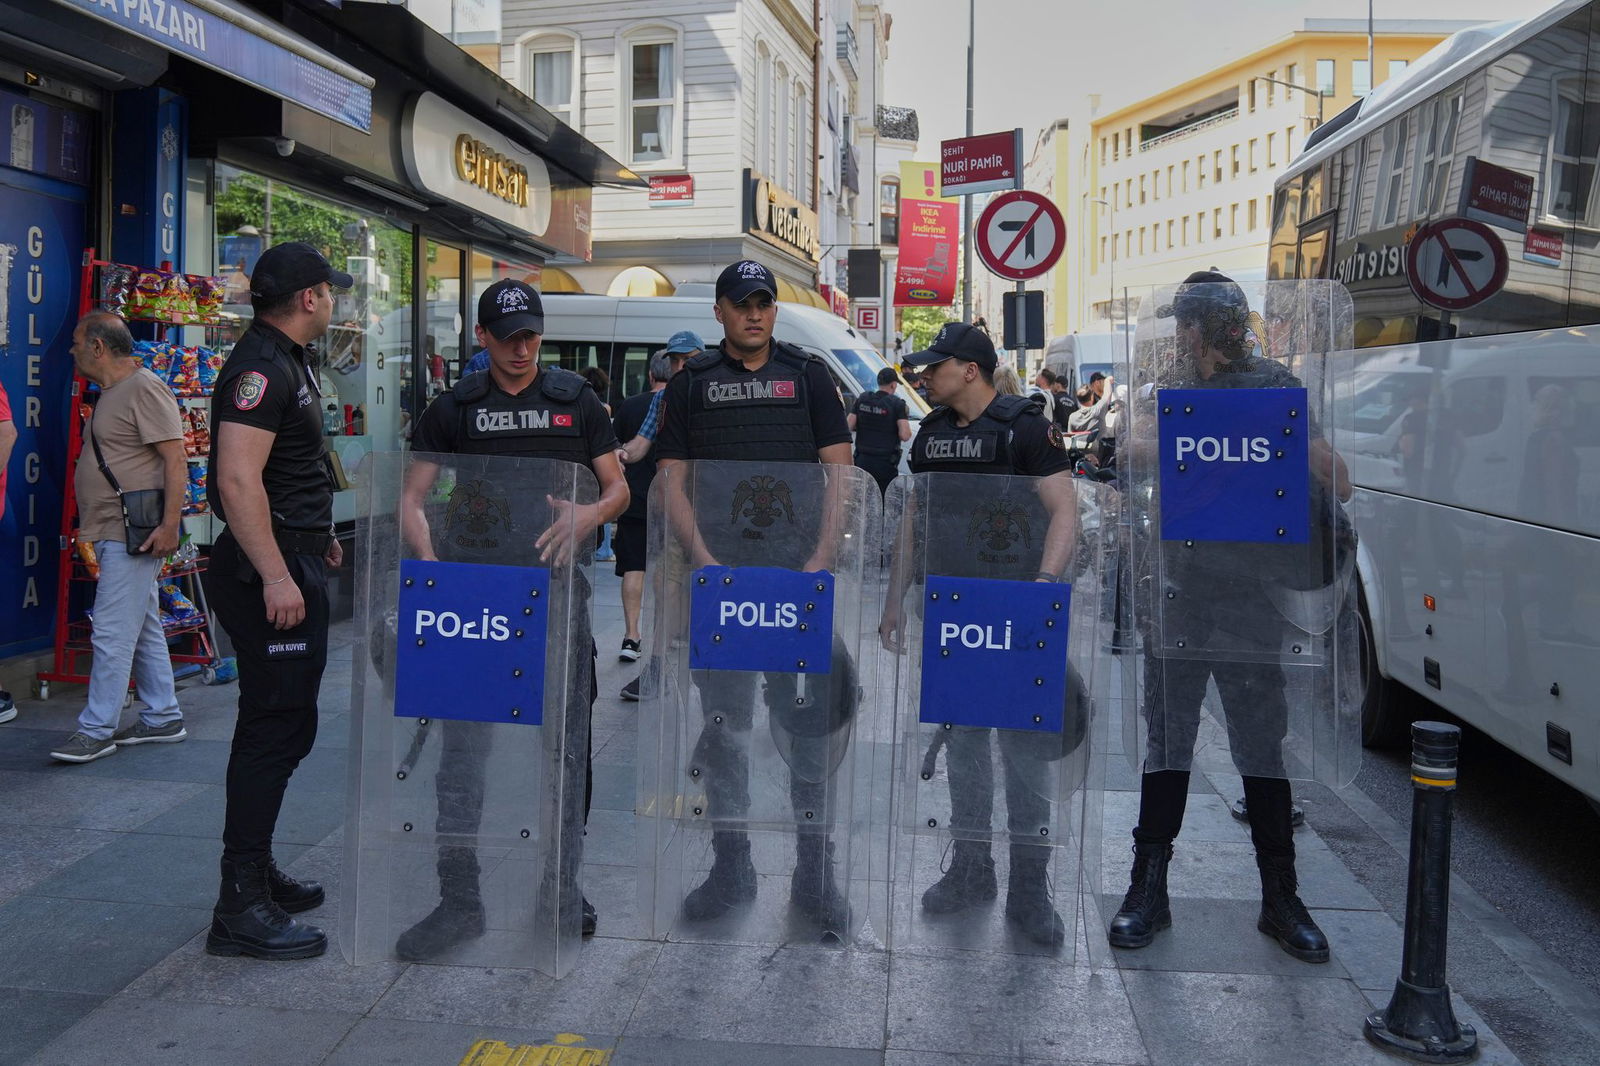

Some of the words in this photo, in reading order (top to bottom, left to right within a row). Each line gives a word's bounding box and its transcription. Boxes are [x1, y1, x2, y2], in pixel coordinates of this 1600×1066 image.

[121, 0, 206, 51] PAZARI
[943, 146, 965, 158] ŞEHİT
[456, 134, 529, 208] emsan
[943, 158, 968, 174] NURİ
[970, 154, 1003, 171] PAMİR
[943, 175, 966, 184] SOKAĞI
[920, 207, 939, 216] IKEA
[923, 216, 937, 225] Yaz
[911, 290, 937, 298] IKEA
[26, 226, 43, 428] GÜLER
[863, 312, 873, 325] E
[708, 382, 746, 402] ÖZEL
[744, 378, 772, 399] TİM
[476, 409, 518, 432] ÖZEL
[925, 436, 955, 459] ÖZEL
[956, 435, 982, 457] TİM
[1176, 437, 1270, 463] POLIS
[22, 452, 41, 608] GIDA
[268, 643, 285, 654] ÇEVİK
[285, 643, 306, 652] KUVVET
